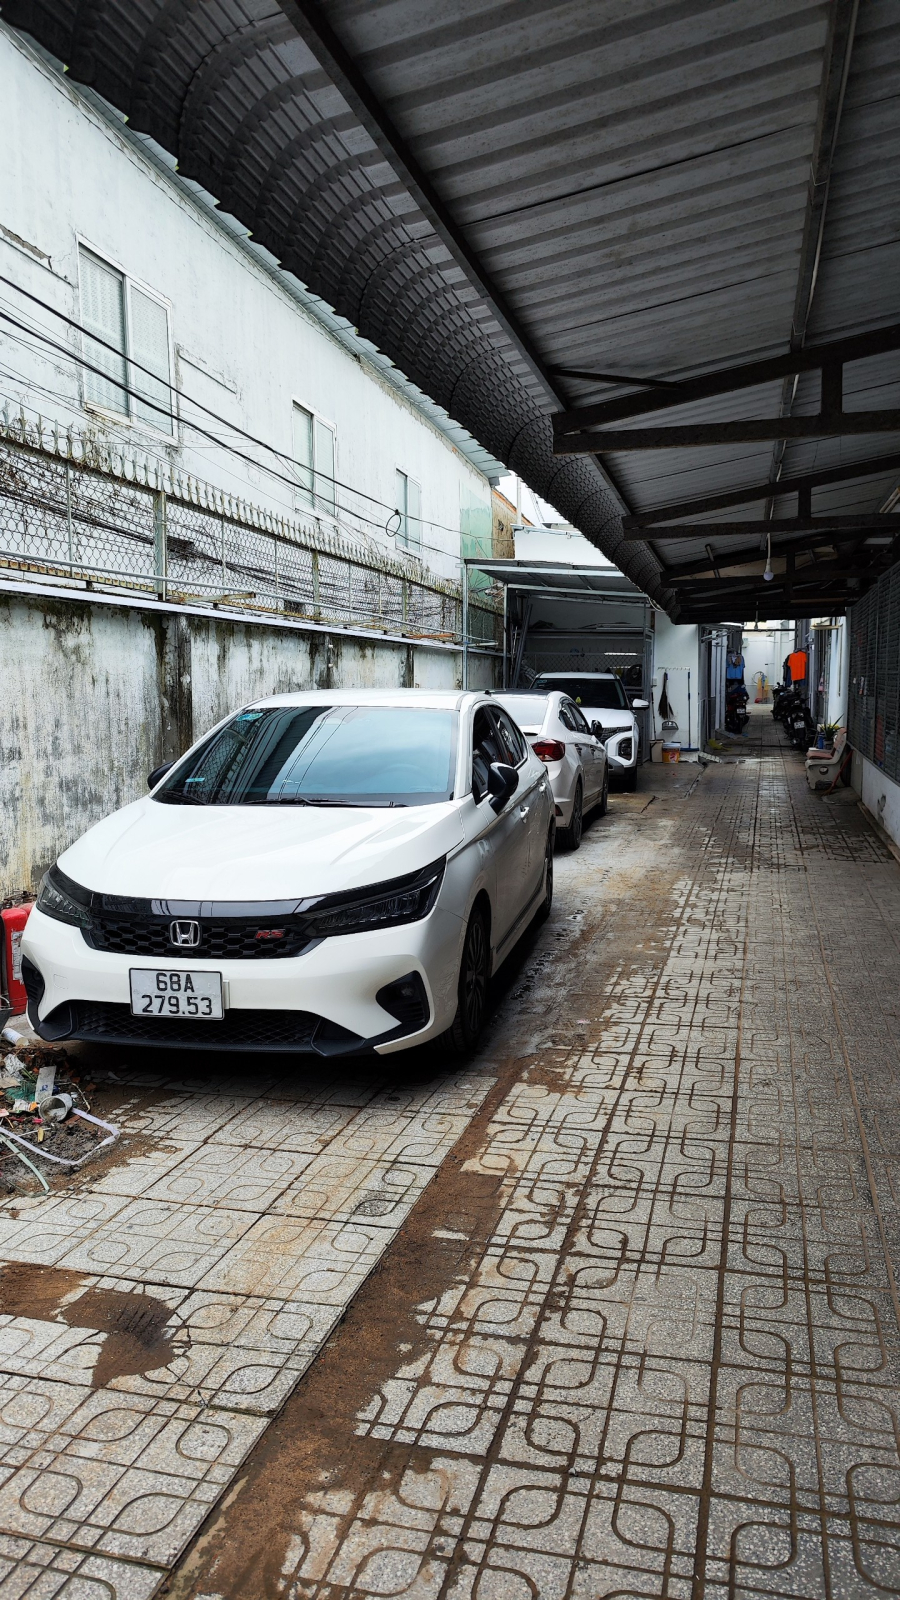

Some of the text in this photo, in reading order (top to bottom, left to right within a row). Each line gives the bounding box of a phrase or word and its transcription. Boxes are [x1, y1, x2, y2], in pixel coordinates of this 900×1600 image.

[254, 928, 285, 939] RS
[156, 972, 195, 993] 68A
[141, 995, 212, 1016] 279.53
